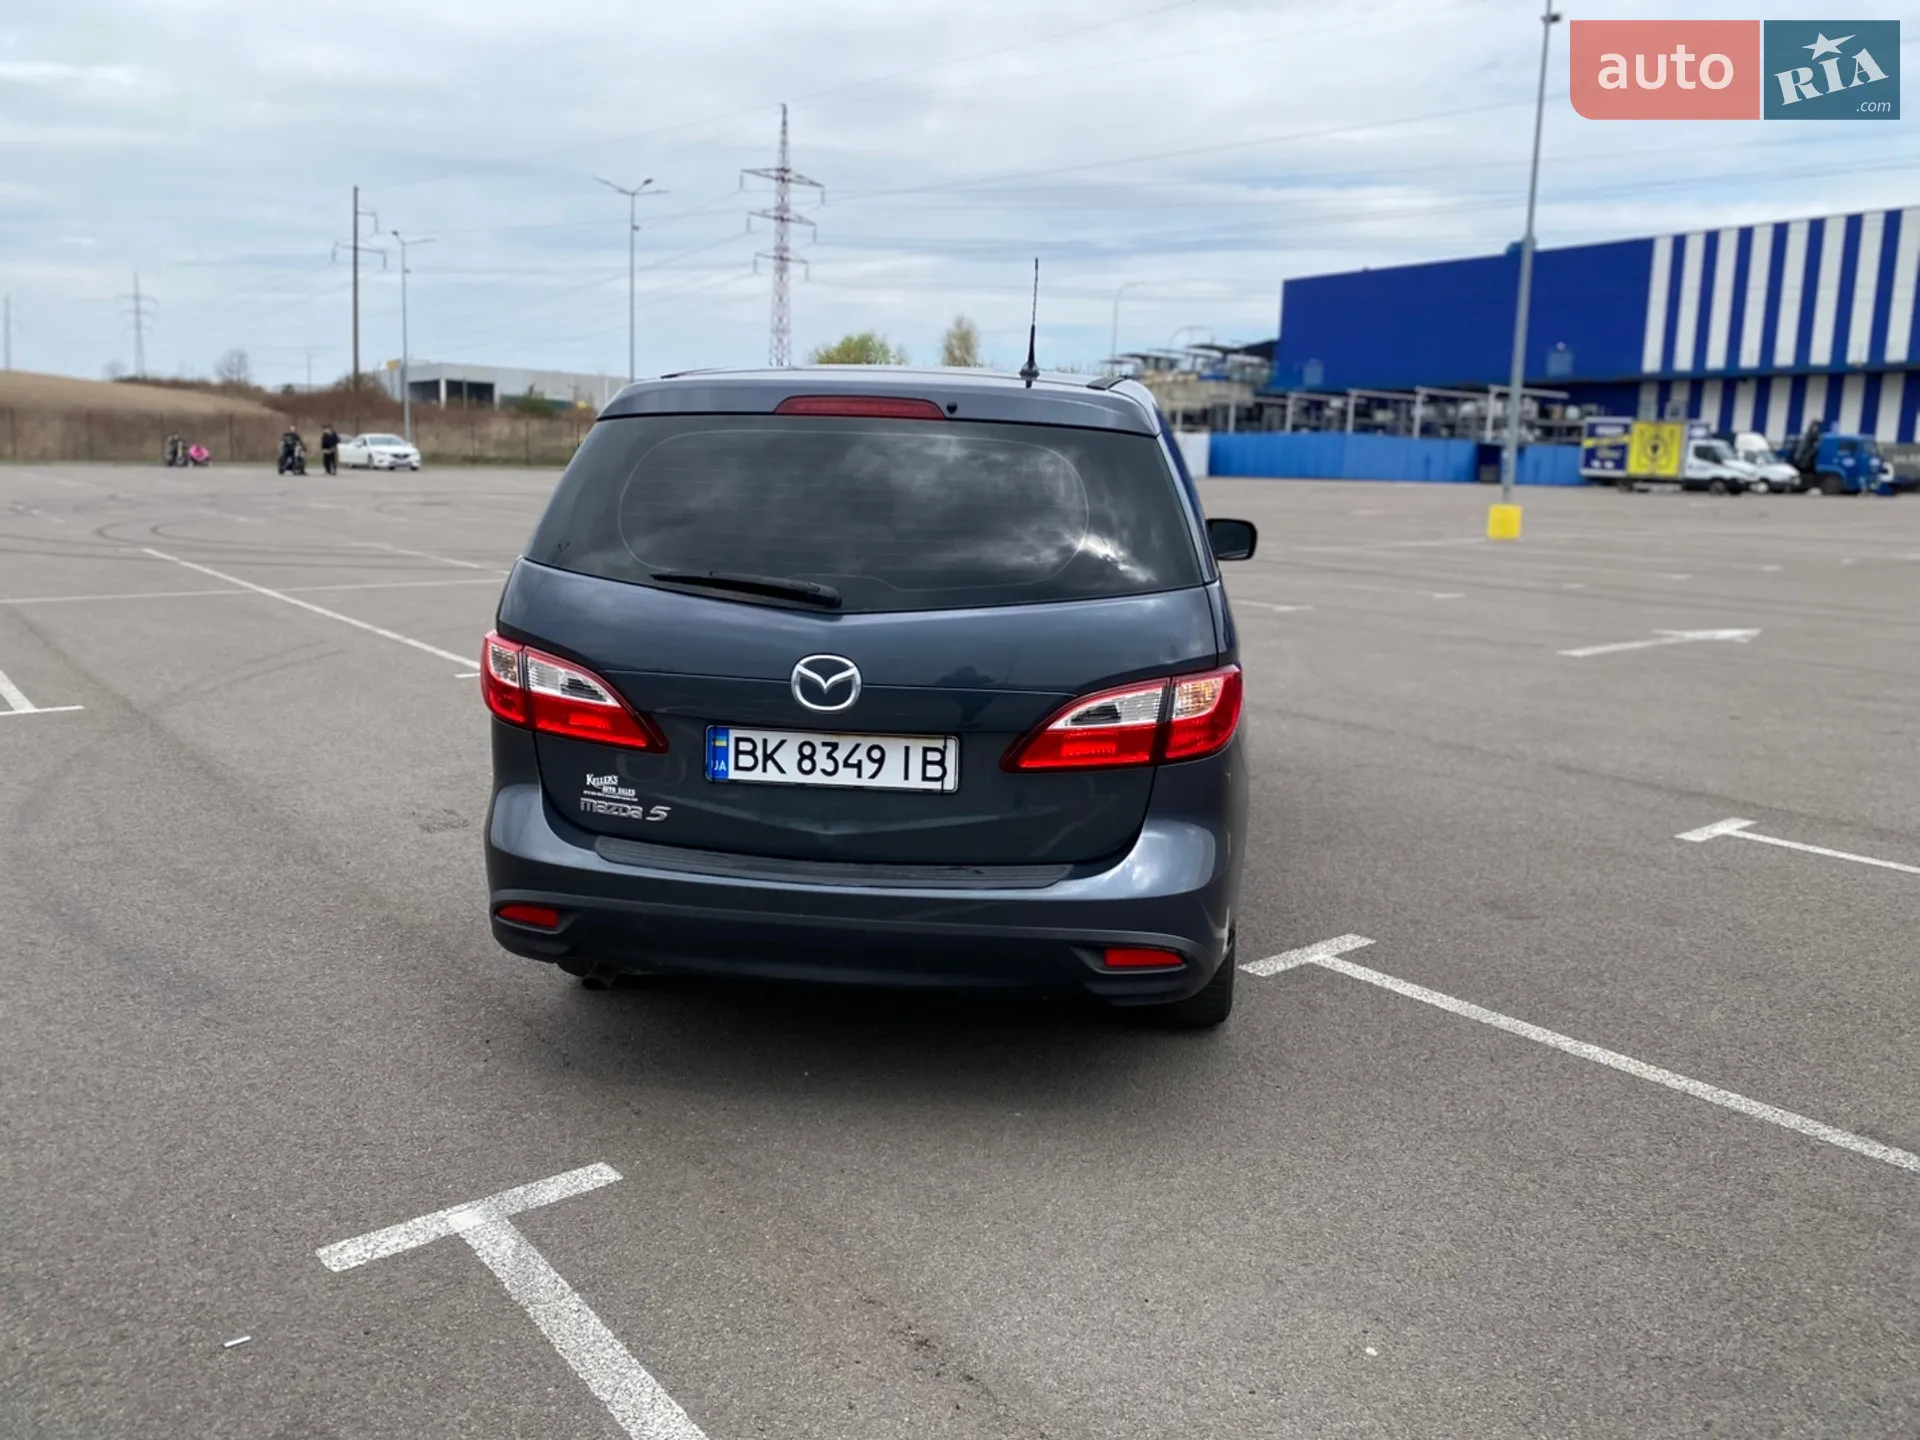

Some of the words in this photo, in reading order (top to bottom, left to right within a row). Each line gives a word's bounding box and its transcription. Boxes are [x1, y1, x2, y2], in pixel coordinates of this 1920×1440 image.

[733, 736, 788, 775] BK
[797, 740, 886, 780] 8349
[903, 745, 948, 783] IB
[645, 805, 672, 822] 5
